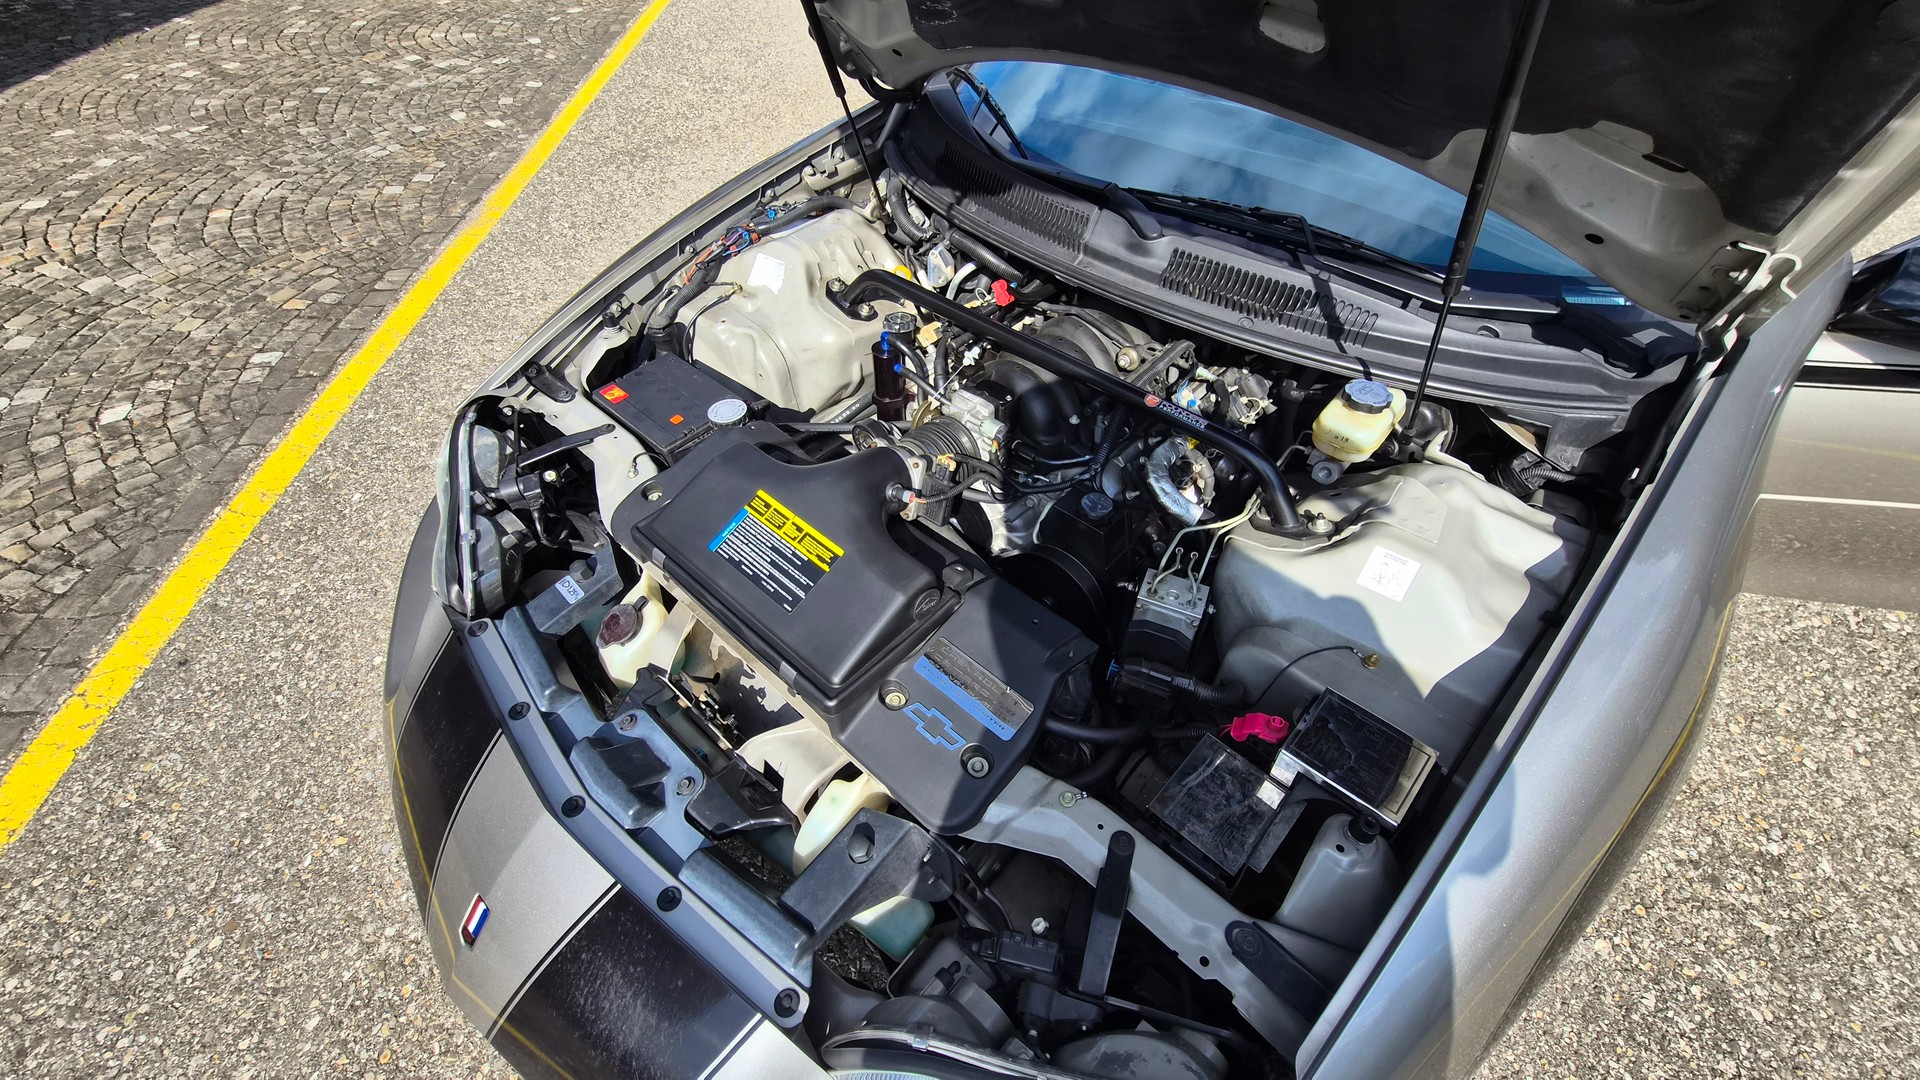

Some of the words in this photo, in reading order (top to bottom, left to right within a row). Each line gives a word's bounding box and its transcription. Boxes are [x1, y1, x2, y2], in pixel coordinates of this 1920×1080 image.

[1158, 405, 1206, 430] PERFORMANCE
[932, 653, 992, 699] CAMARO
[940, 646, 1019, 707] CHEVROLET
